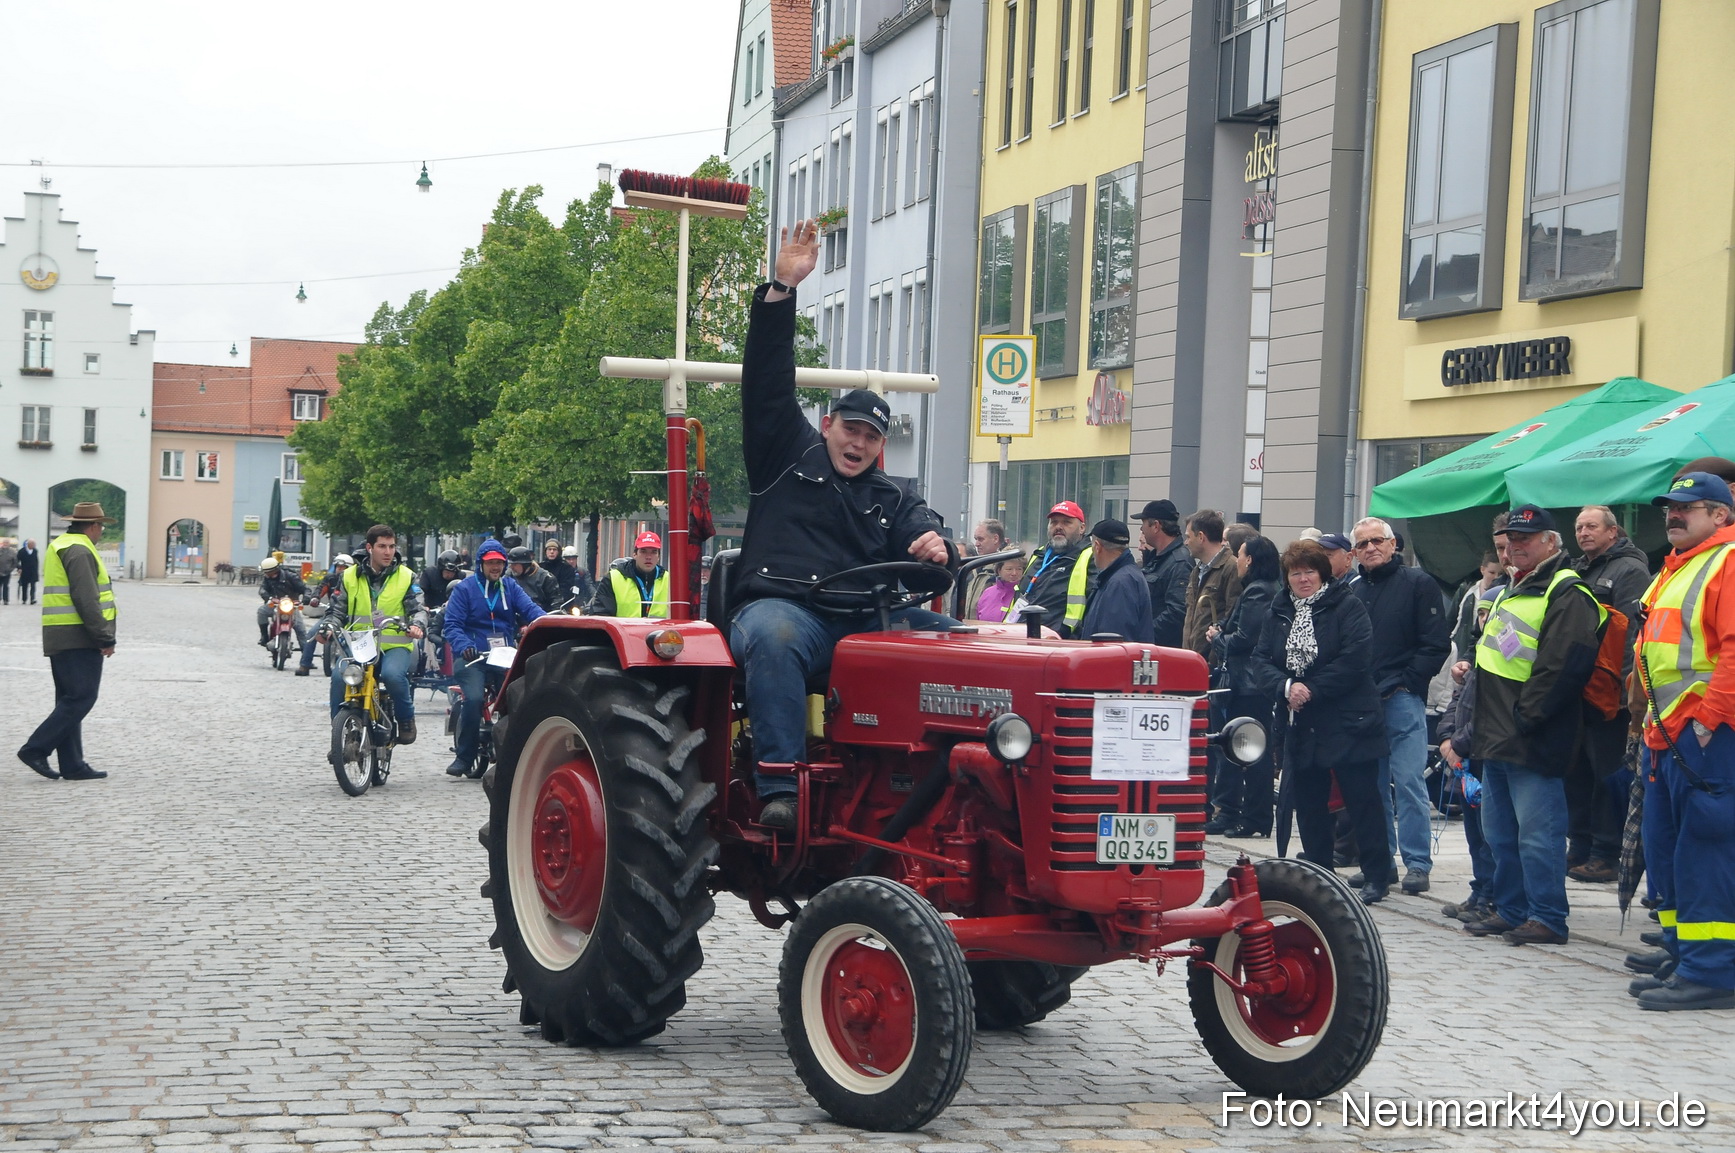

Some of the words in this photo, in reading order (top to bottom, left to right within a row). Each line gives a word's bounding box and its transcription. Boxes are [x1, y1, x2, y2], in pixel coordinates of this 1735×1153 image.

[1441, 344, 1502, 387] GERRY
[1502, 336, 1571, 381] WEBER
[853, 712, 879, 726] DIESEL
[1139, 713, 1170, 732] 456
[1115, 818, 1140, 838] NM
[1106, 840, 1130, 860] QQ
[1134, 841, 1168, 860] 345
